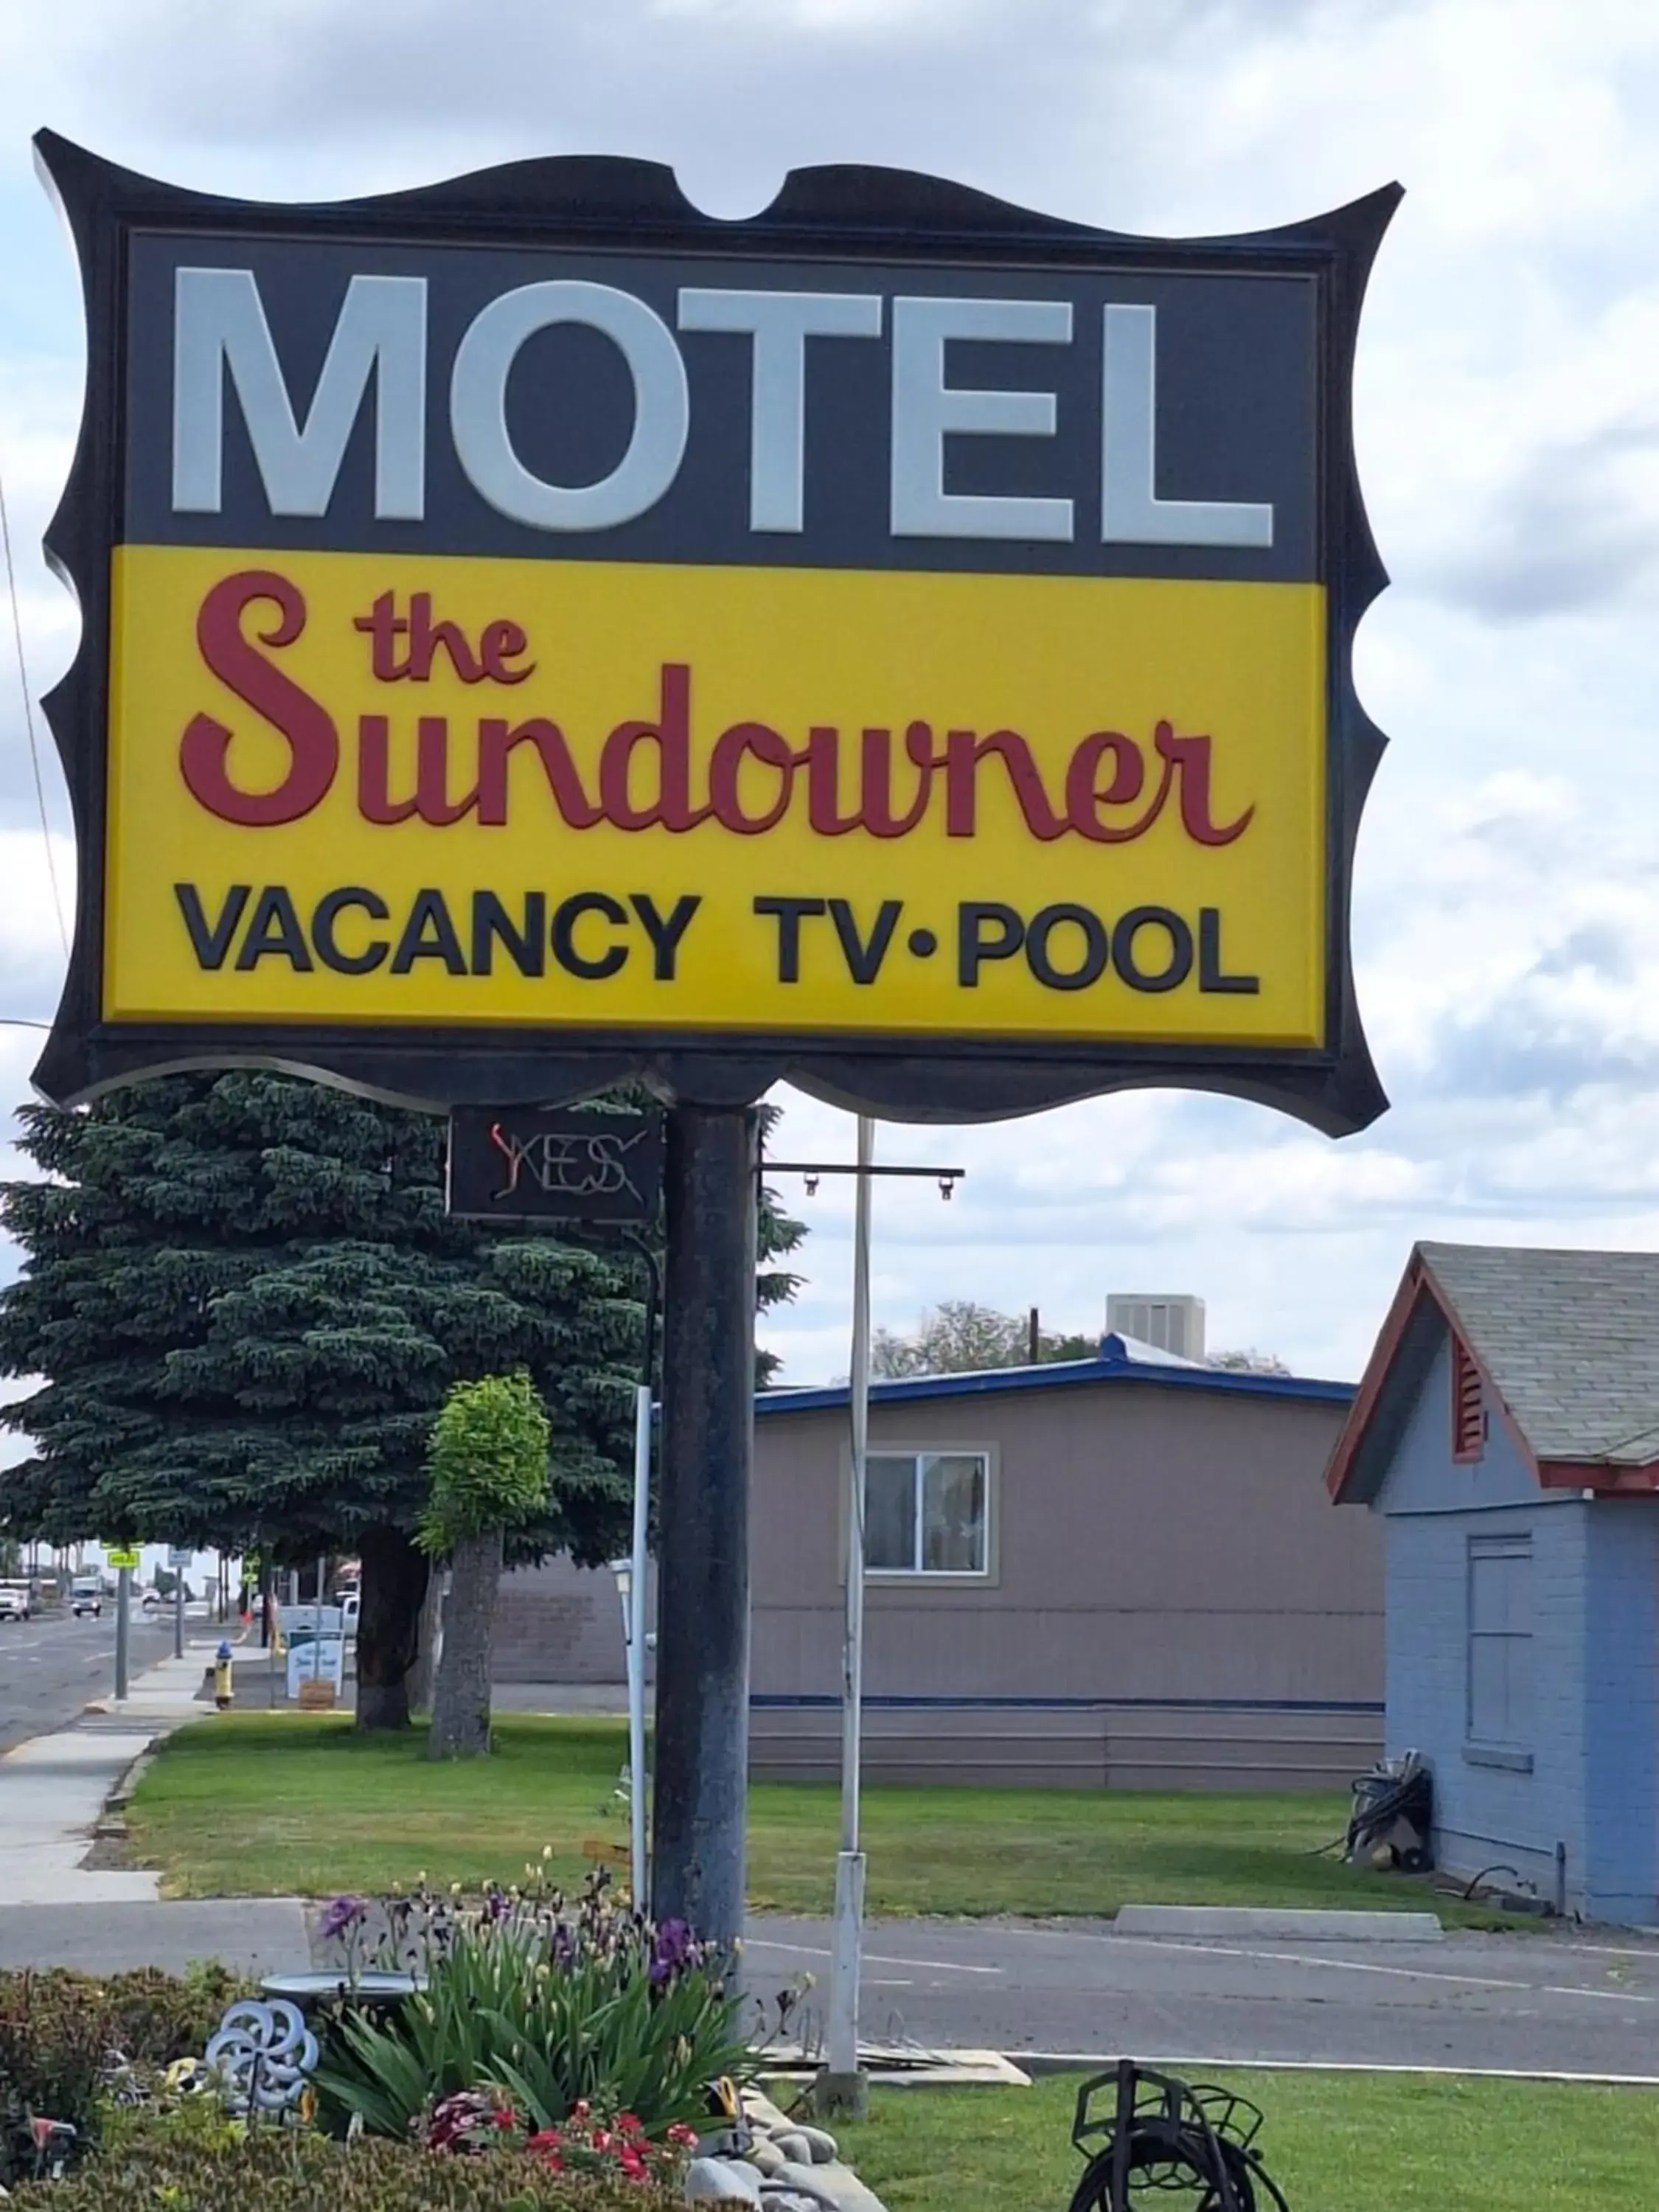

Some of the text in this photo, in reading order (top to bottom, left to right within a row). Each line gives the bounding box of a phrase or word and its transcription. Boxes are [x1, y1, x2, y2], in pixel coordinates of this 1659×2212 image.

[172, 266, 1275, 548] MOTEL
[179, 570, 1256, 846] Sundowner
[353, 590, 537, 685] the
[174, 883, 703, 981] VACANCY
